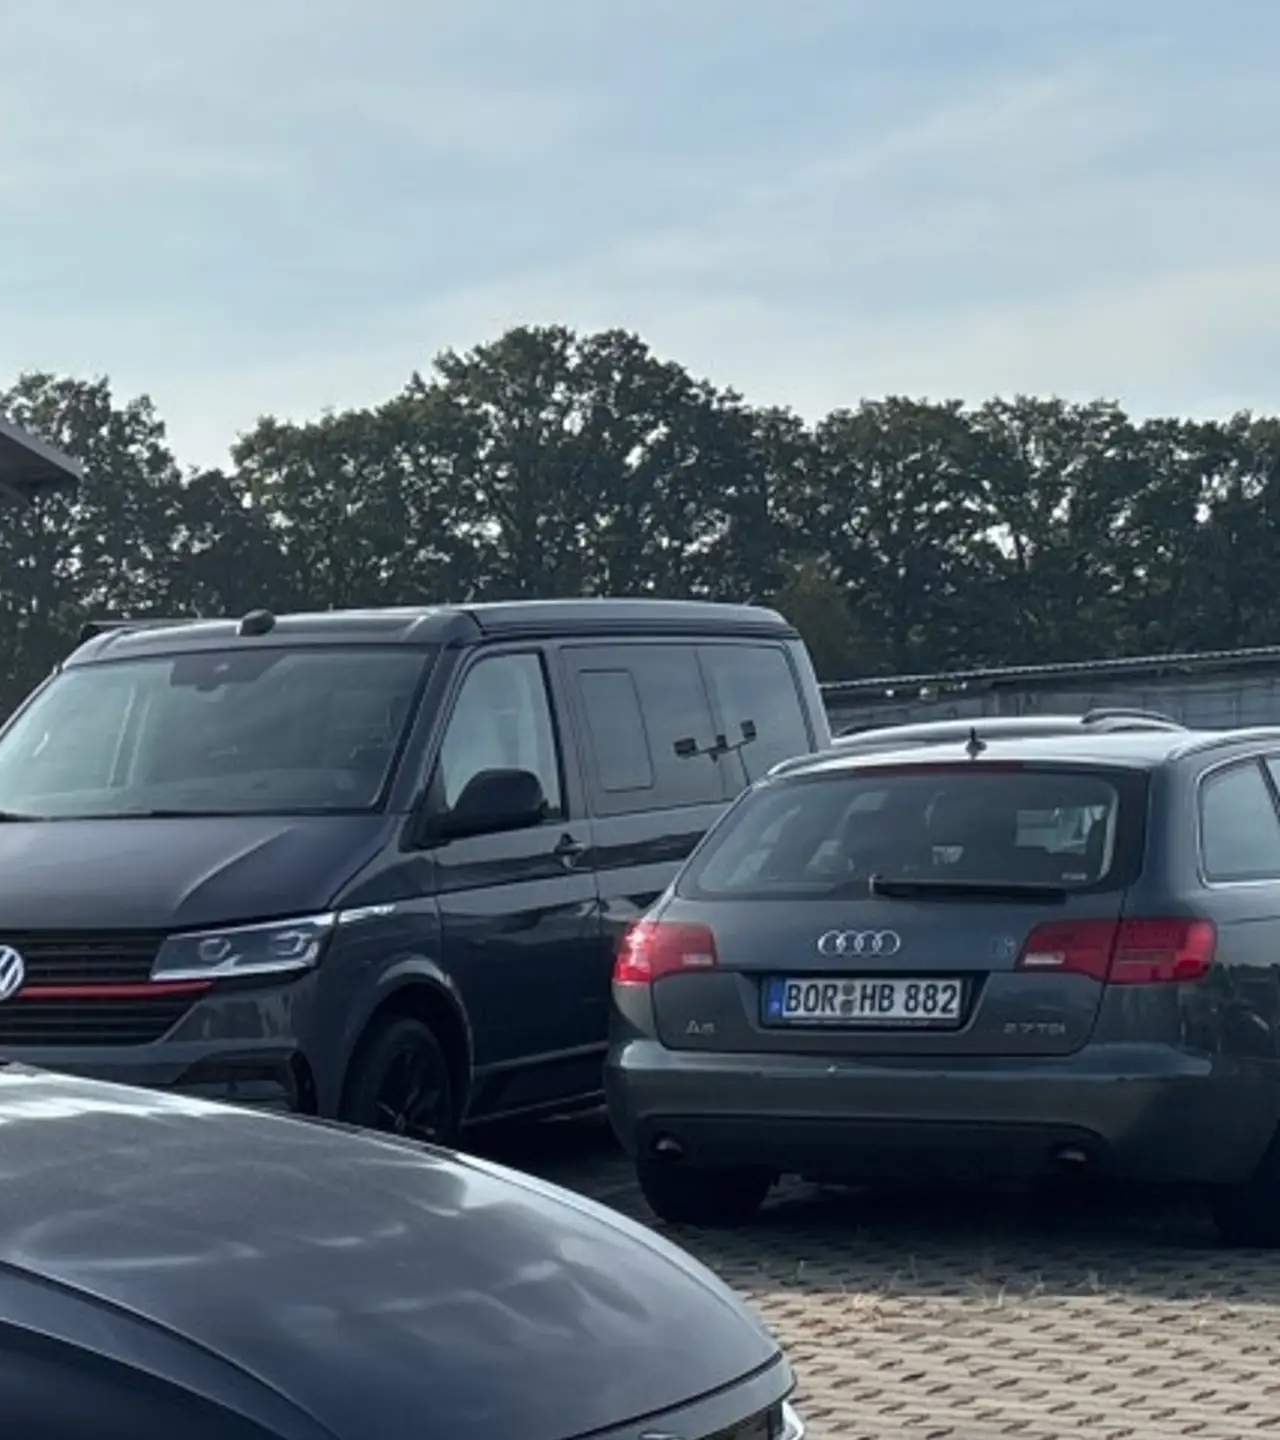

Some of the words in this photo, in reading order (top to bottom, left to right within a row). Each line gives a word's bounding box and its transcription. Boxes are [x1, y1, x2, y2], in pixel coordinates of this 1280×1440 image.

[785, 983, 838, 1013] BOR
[859, 983, 895, 1013] HB
[904, 983, 958, 1014] 882
